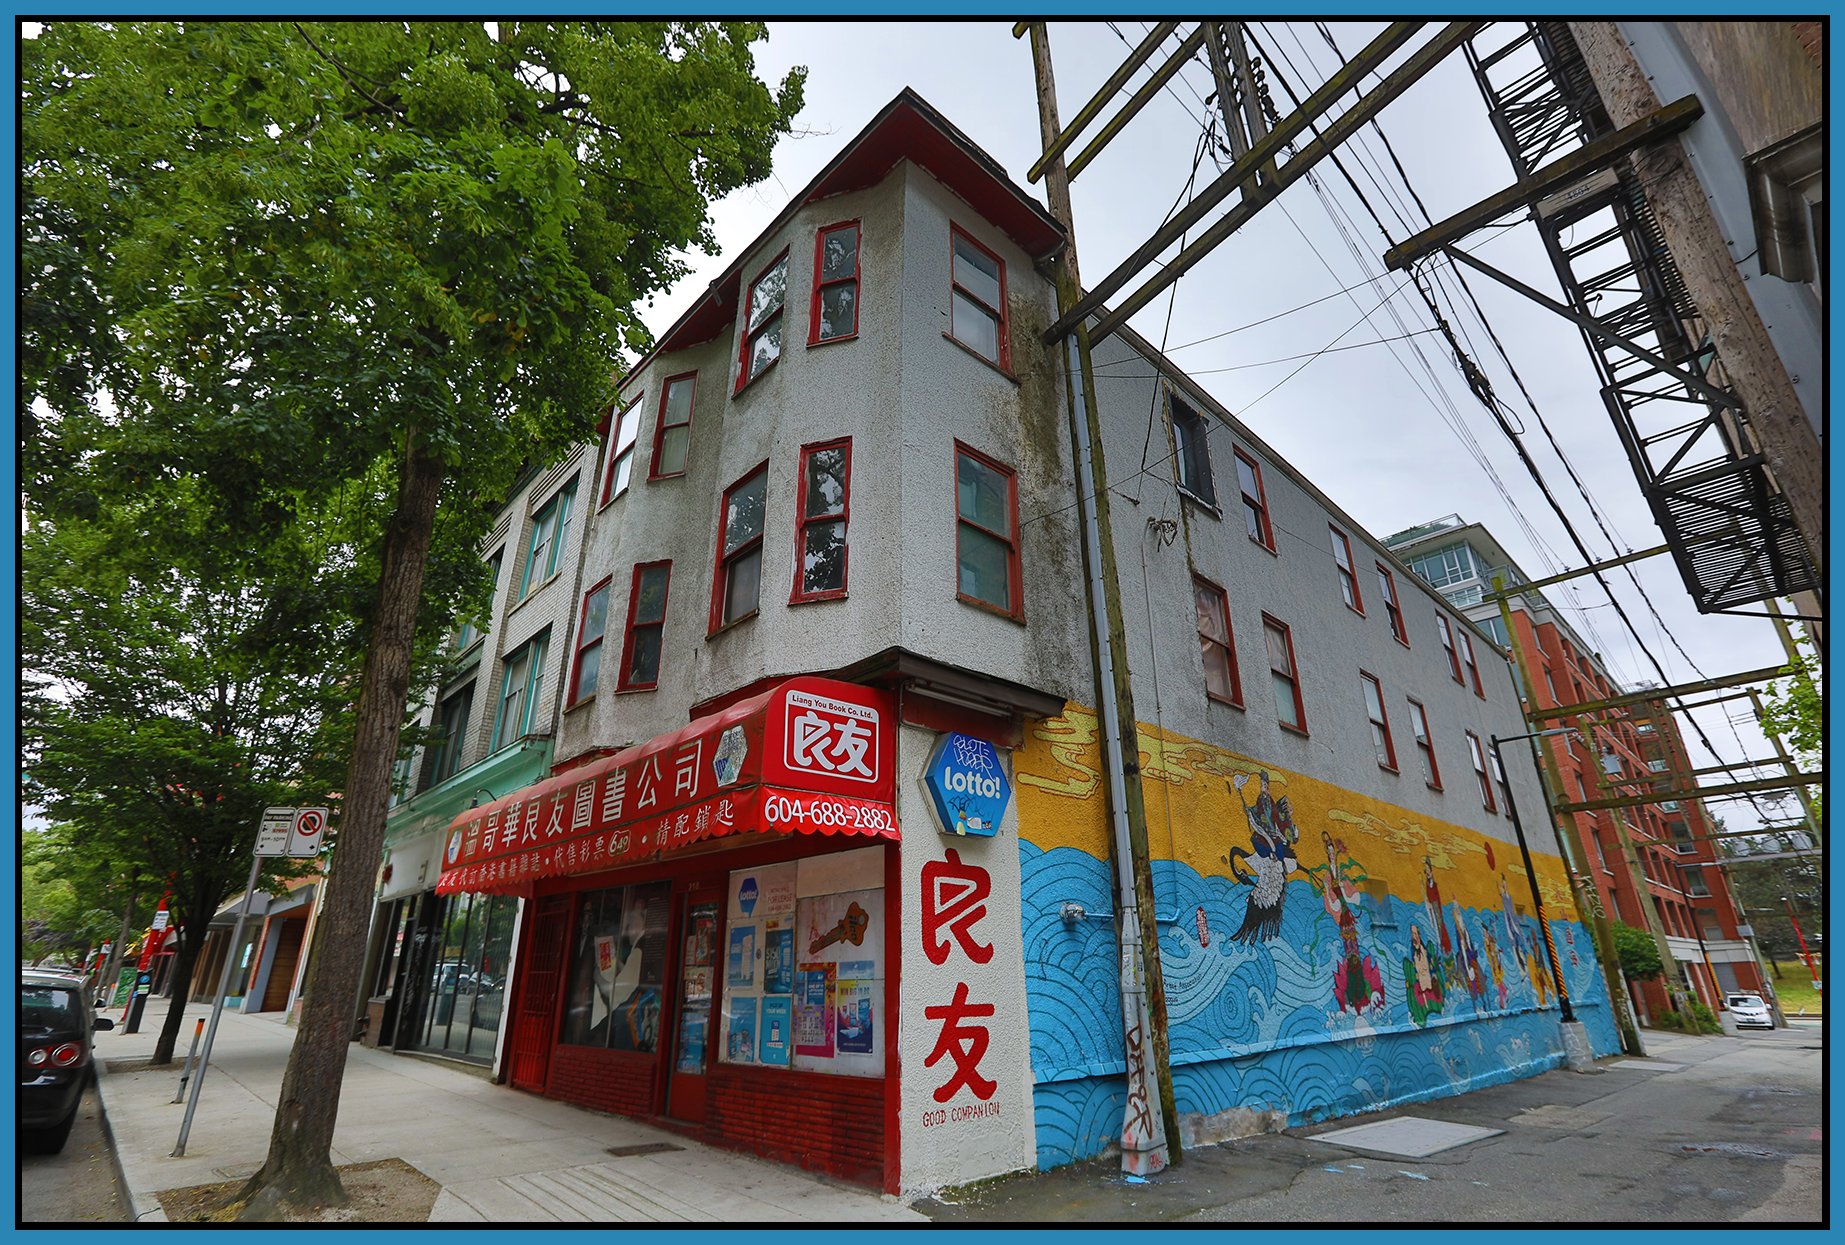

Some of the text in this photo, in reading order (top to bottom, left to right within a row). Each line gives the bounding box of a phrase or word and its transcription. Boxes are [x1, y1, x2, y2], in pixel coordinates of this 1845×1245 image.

[792, 694, 873, 719] Liang You Book Co. Ltd.
[793, 710, 873, 777] 良友
[944, 766, 1001, 800] lotto!
[764, 795, 896, 832] 604-688-2882
[922, 1101, 1000, 1128] GOOD COMPANION
